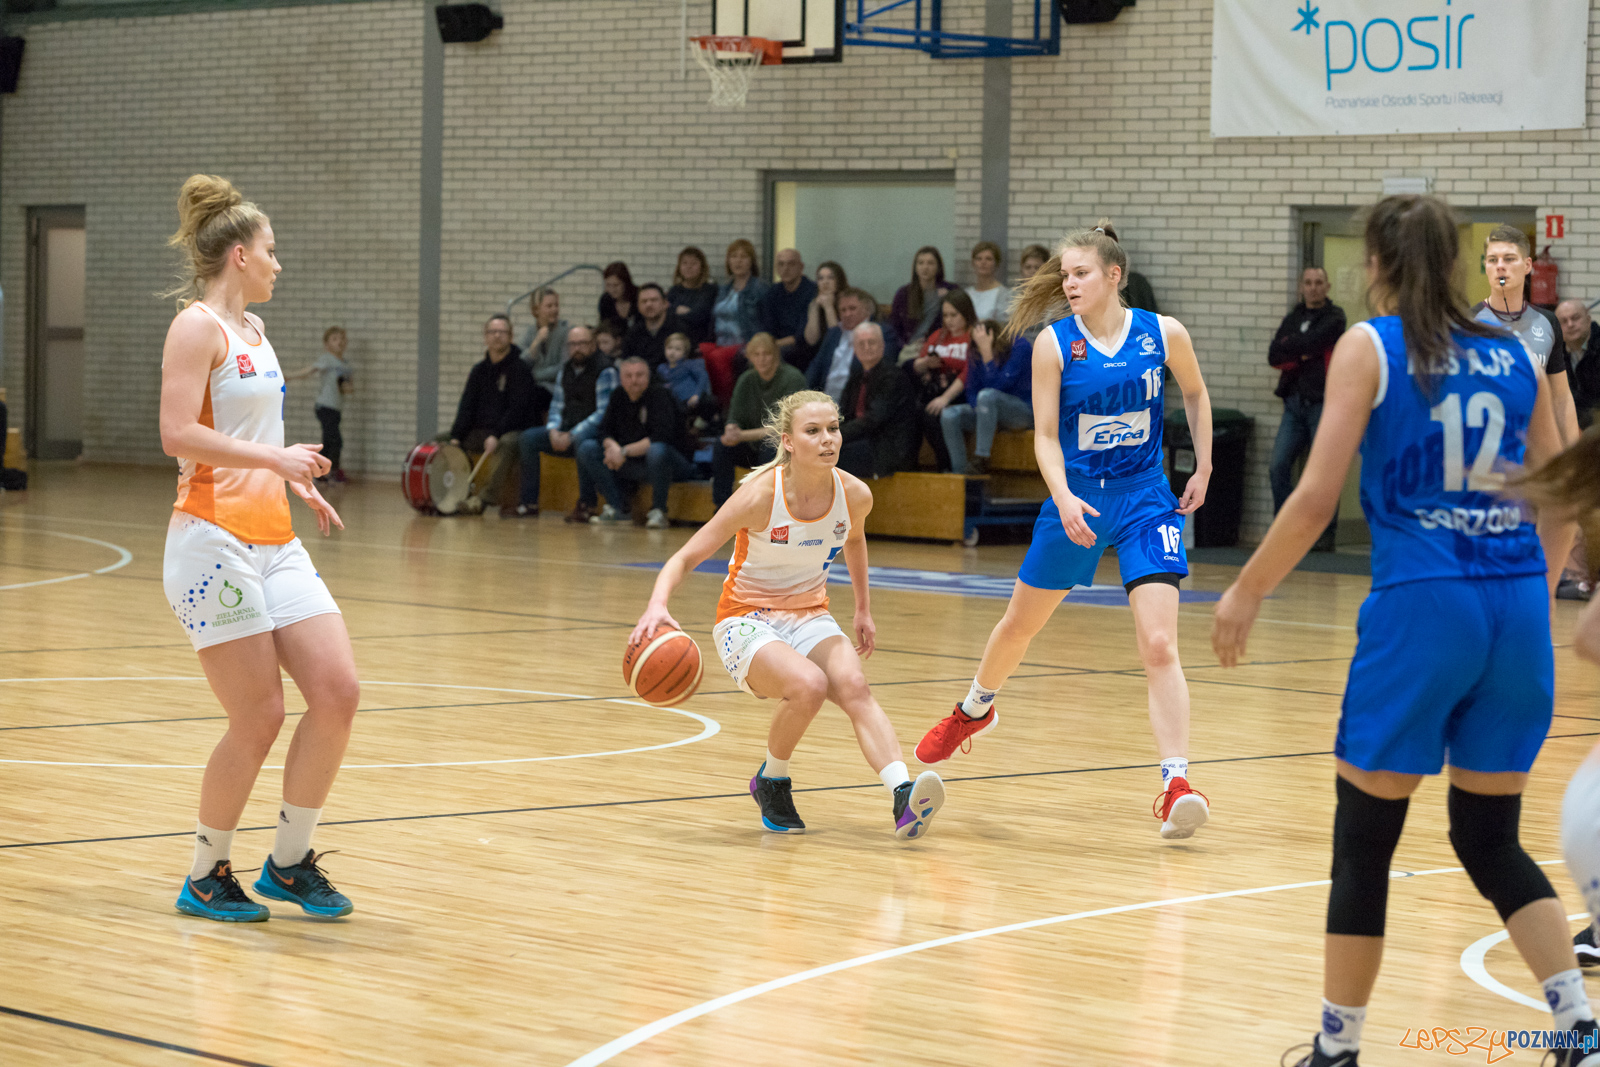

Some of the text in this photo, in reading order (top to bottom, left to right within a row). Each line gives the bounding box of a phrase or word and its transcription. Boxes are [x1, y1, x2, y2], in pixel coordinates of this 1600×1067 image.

[1325, 0, 1475, 91] posir
[1418, 92, 1452, 107] Sportu
[1458, 90, 1503, 106] Rekreacji
[1093, 428, 1145, 445] Enea
[1430, 391, 1505, 491] 12
[1157, 524, 1180, 554] 16
[212, 612, 261, 627] HERBAFLORIS
[216, 606, 255, 619] ZIELARNIA
